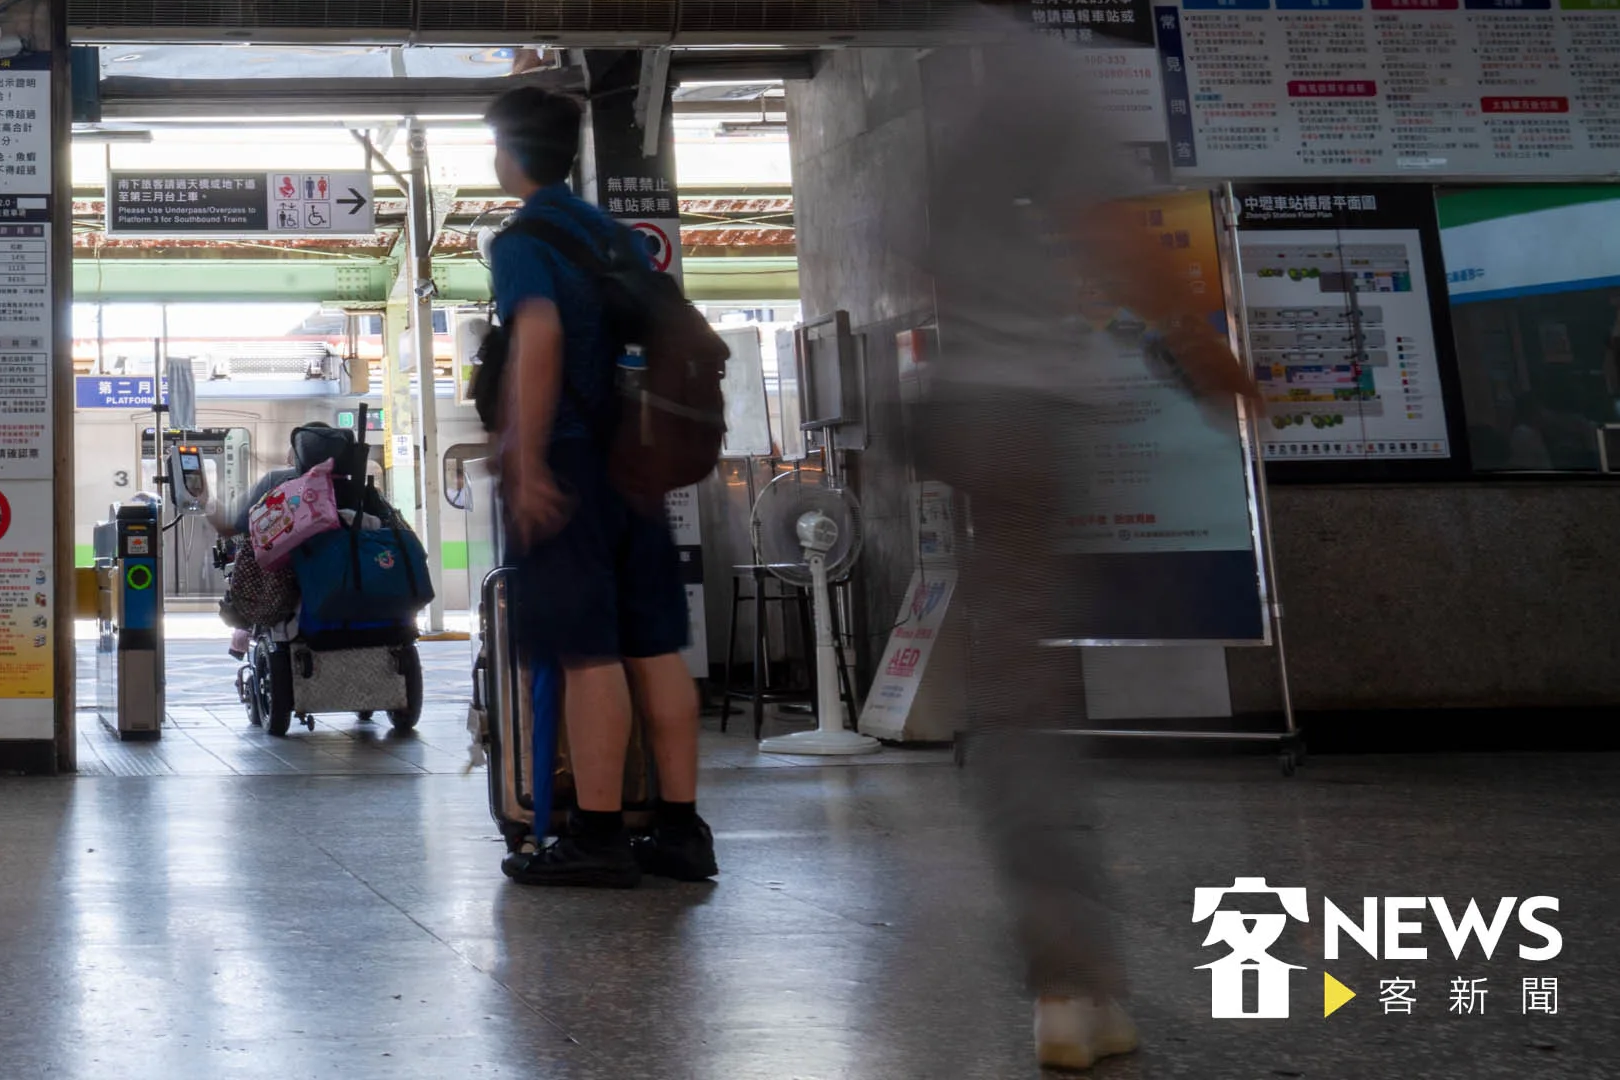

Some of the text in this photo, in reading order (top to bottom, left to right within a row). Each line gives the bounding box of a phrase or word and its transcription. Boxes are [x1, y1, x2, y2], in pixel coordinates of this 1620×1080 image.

[607, 177, 670, 192] 無票禁止
[608, 197, 672, 213] 進站乘車
[1244, 195, 1377, 211] 中壢車站樓層平面圖
[118, 206, 144, 214] Please
[147, 206, 162, 214] Use
[165, 206, 244, 217] Underpass/Overpass
[1273, 211, 1333, 219] Station Plan
[118, 215, 247, 224] Platform for Southbound Trains
[114, 471, 129, 487] 3
[890, 648, 921, 667] AED
